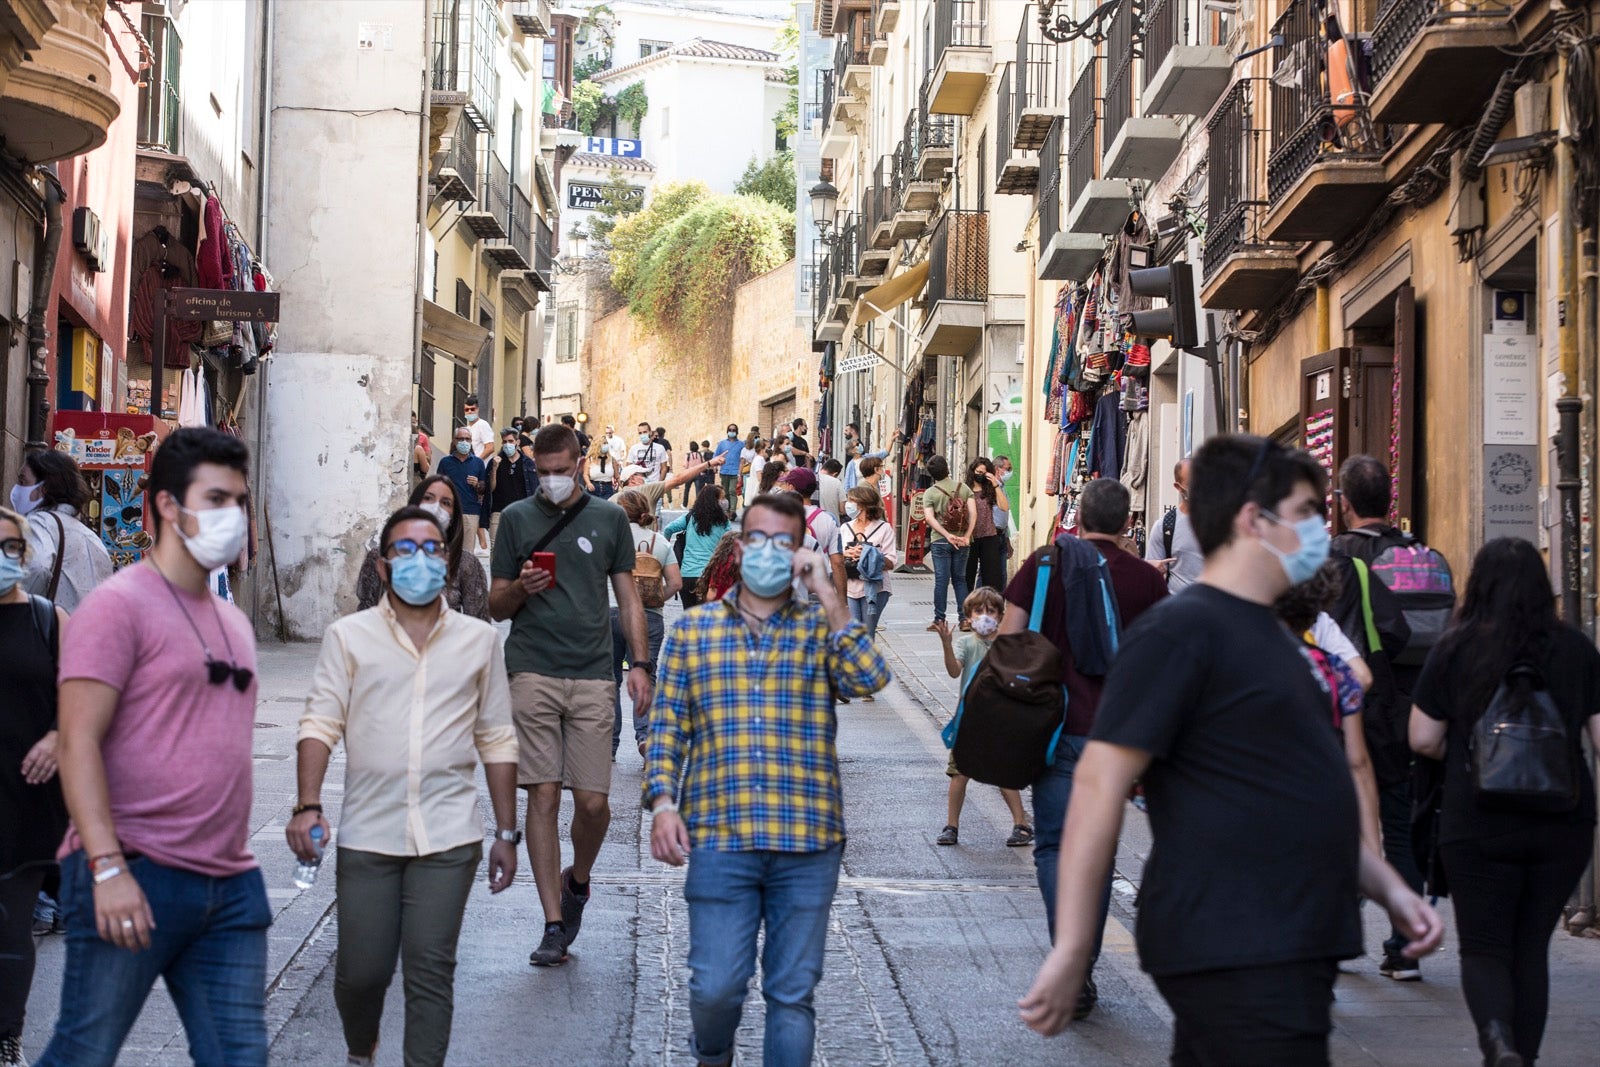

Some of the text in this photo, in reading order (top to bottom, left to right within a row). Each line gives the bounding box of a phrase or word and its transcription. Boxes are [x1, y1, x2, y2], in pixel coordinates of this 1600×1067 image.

[186, 296, 231, 306] oficina de
[216, 307, 251, 318] turismo
